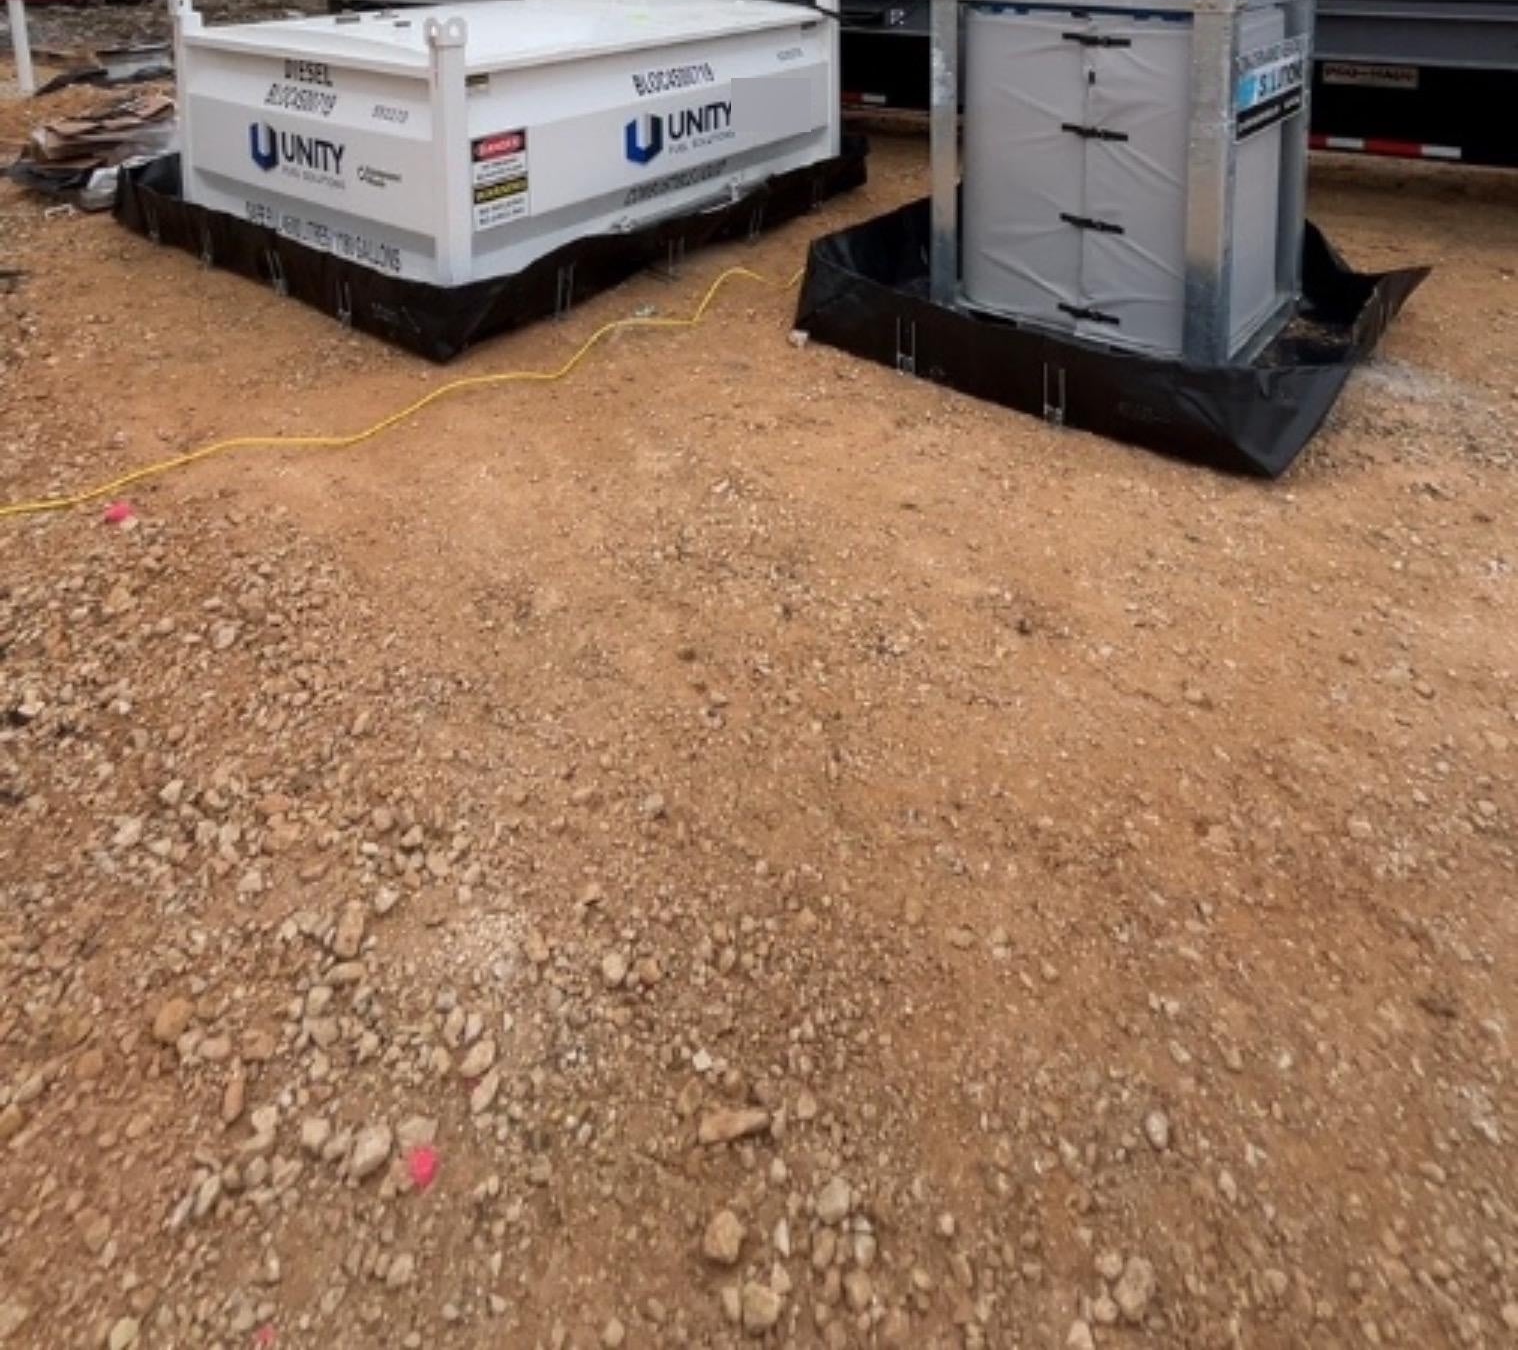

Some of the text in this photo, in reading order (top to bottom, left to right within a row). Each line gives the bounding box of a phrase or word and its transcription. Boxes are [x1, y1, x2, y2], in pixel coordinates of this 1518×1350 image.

[284, 58, 334, 87] DIESEL
[669, 100, 731, 140] UNITY
[281, 131, 345, 175] UNITY
